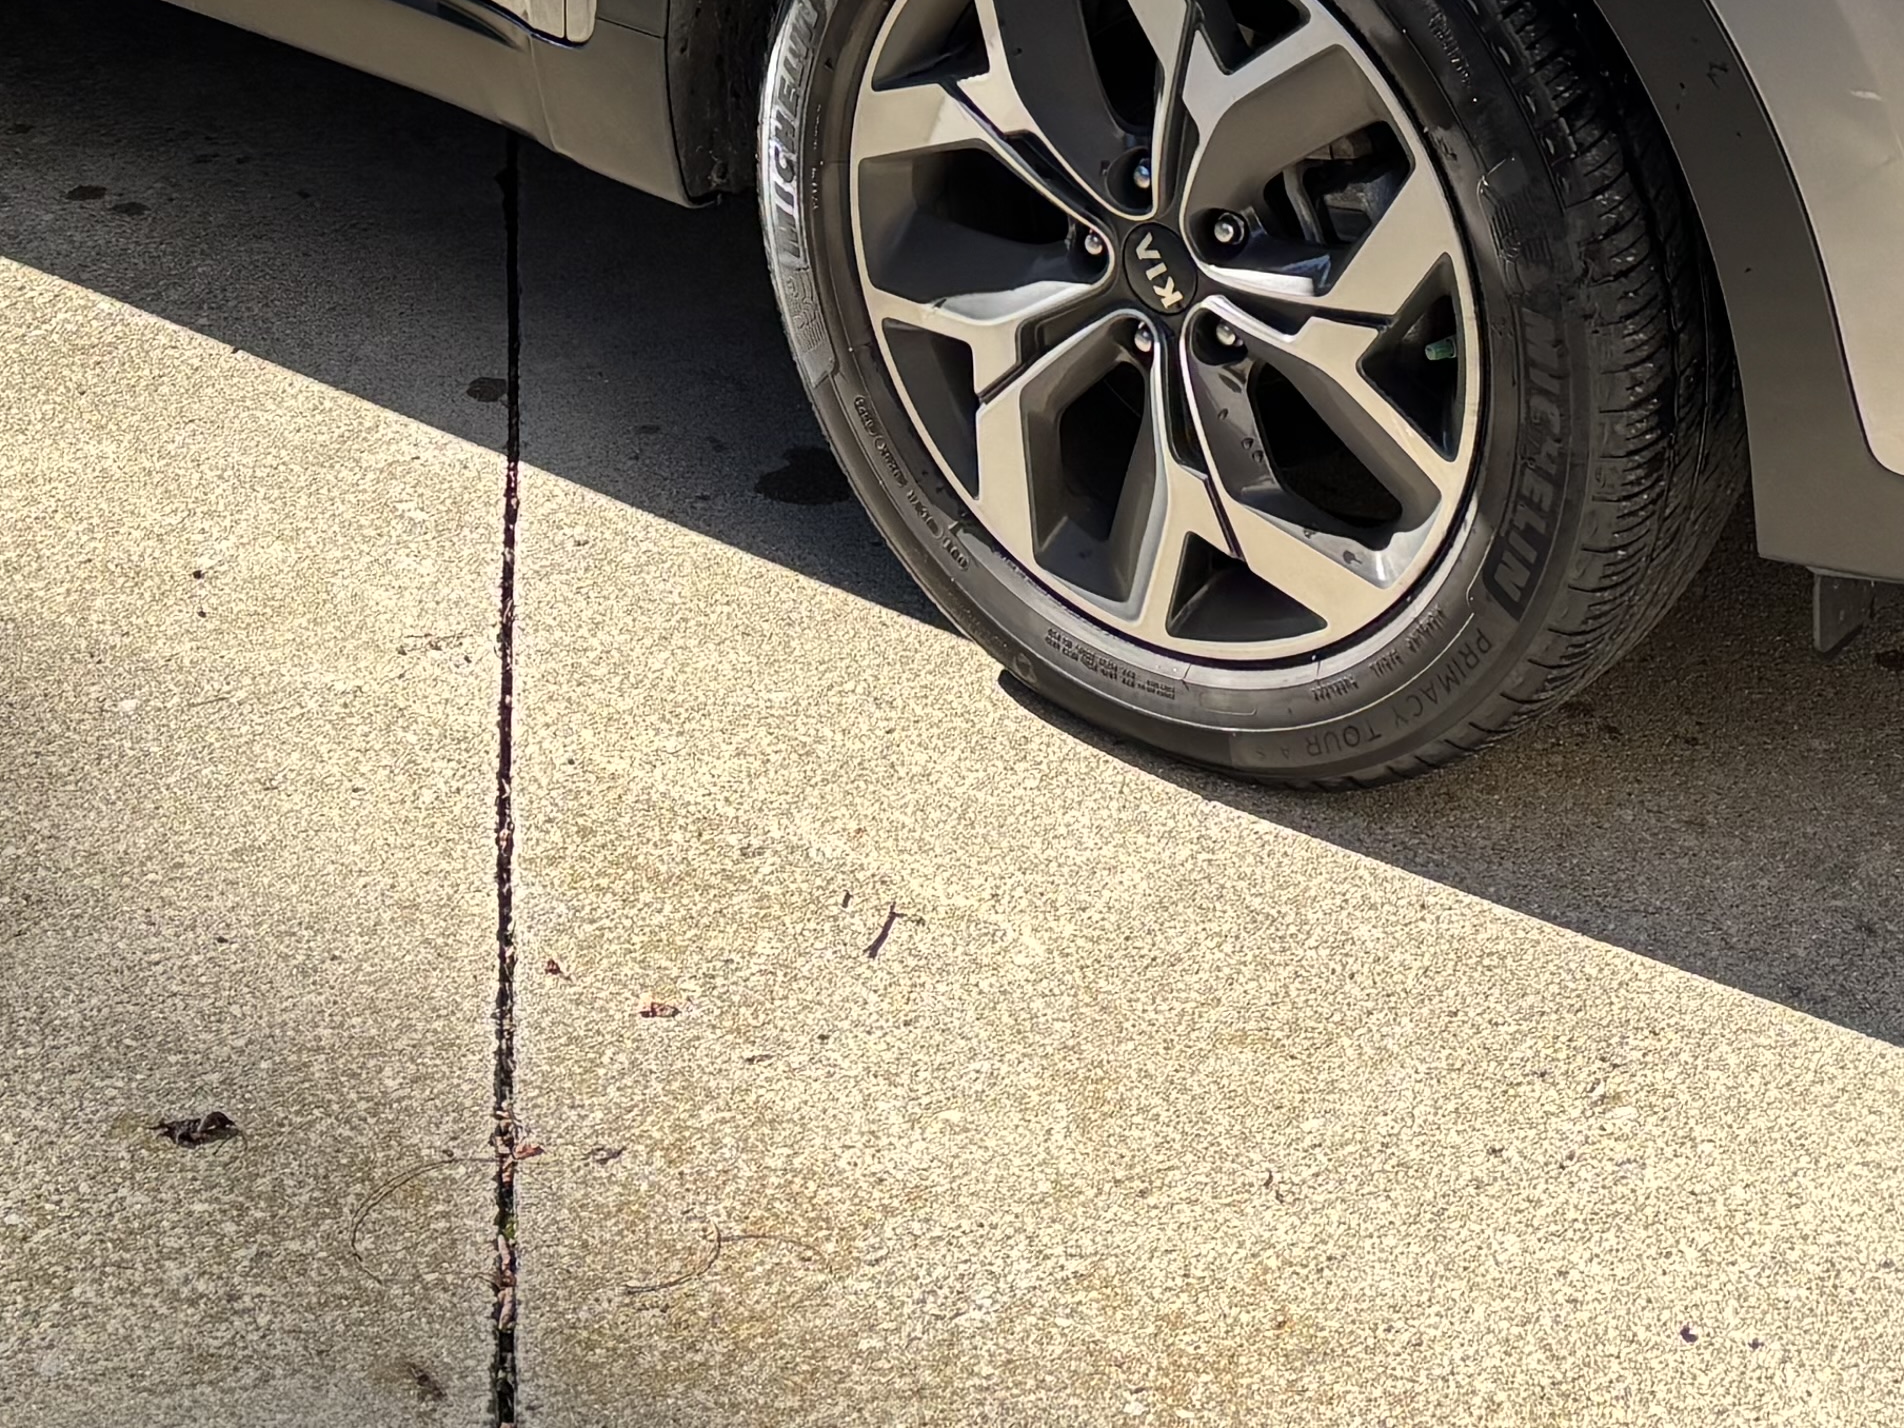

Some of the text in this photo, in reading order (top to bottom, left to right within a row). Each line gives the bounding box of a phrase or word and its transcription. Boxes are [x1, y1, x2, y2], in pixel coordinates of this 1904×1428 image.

[1136, 232, 1183, 309] KIA
[1494, 307, 1562, 604] MICHELIN
[1393, 628, 1492, 731] PRIMACY
[1306, 720, 1382, 757] TOUR
